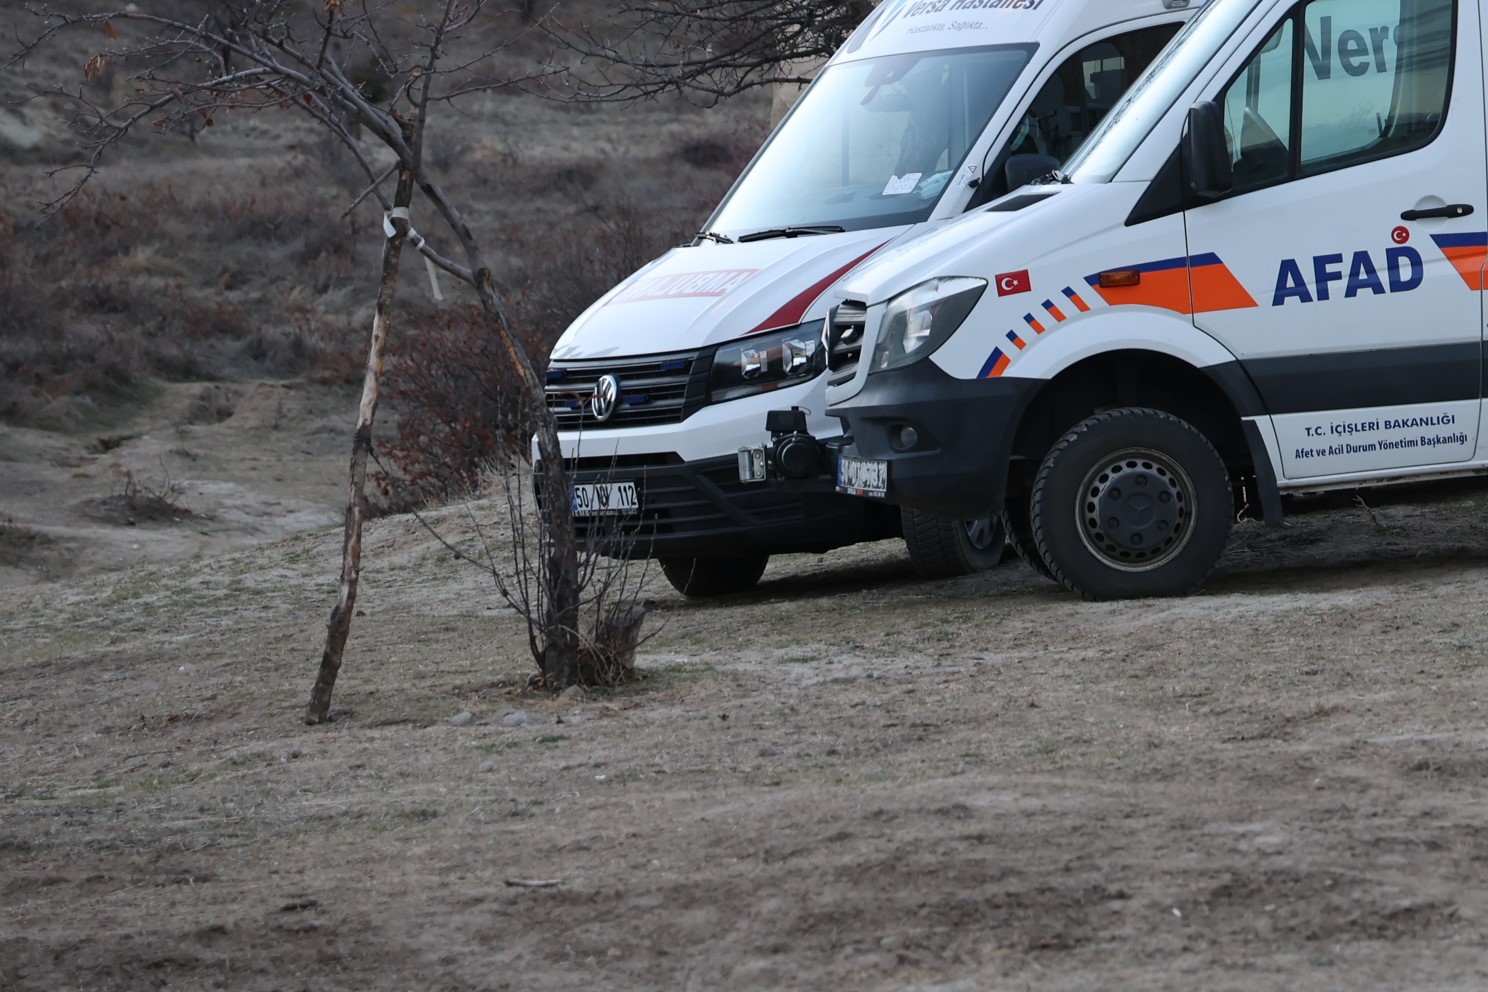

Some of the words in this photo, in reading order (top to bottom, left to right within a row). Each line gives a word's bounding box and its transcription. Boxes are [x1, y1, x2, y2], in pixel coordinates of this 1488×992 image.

[1272, 246, 1424, 307] AFAD
[1305, 426, 1326, 437] T.C.
[1330, 418, 1380, 436] İÇİŞLERİ
[1384, 412, 1455, 430] BAKANLIĞI
[1295, 448, 1314, 459] Afet
[1316, 449, 1326, 457] ve
[1328, 445, 1344, 457] Acil
[1346, 442, 1376, 454] Durum
[1420, 433, 1468, 448] Başkanlığı
[575, 487, 589, 508] 50
[618, 485, 636, 506] 112
